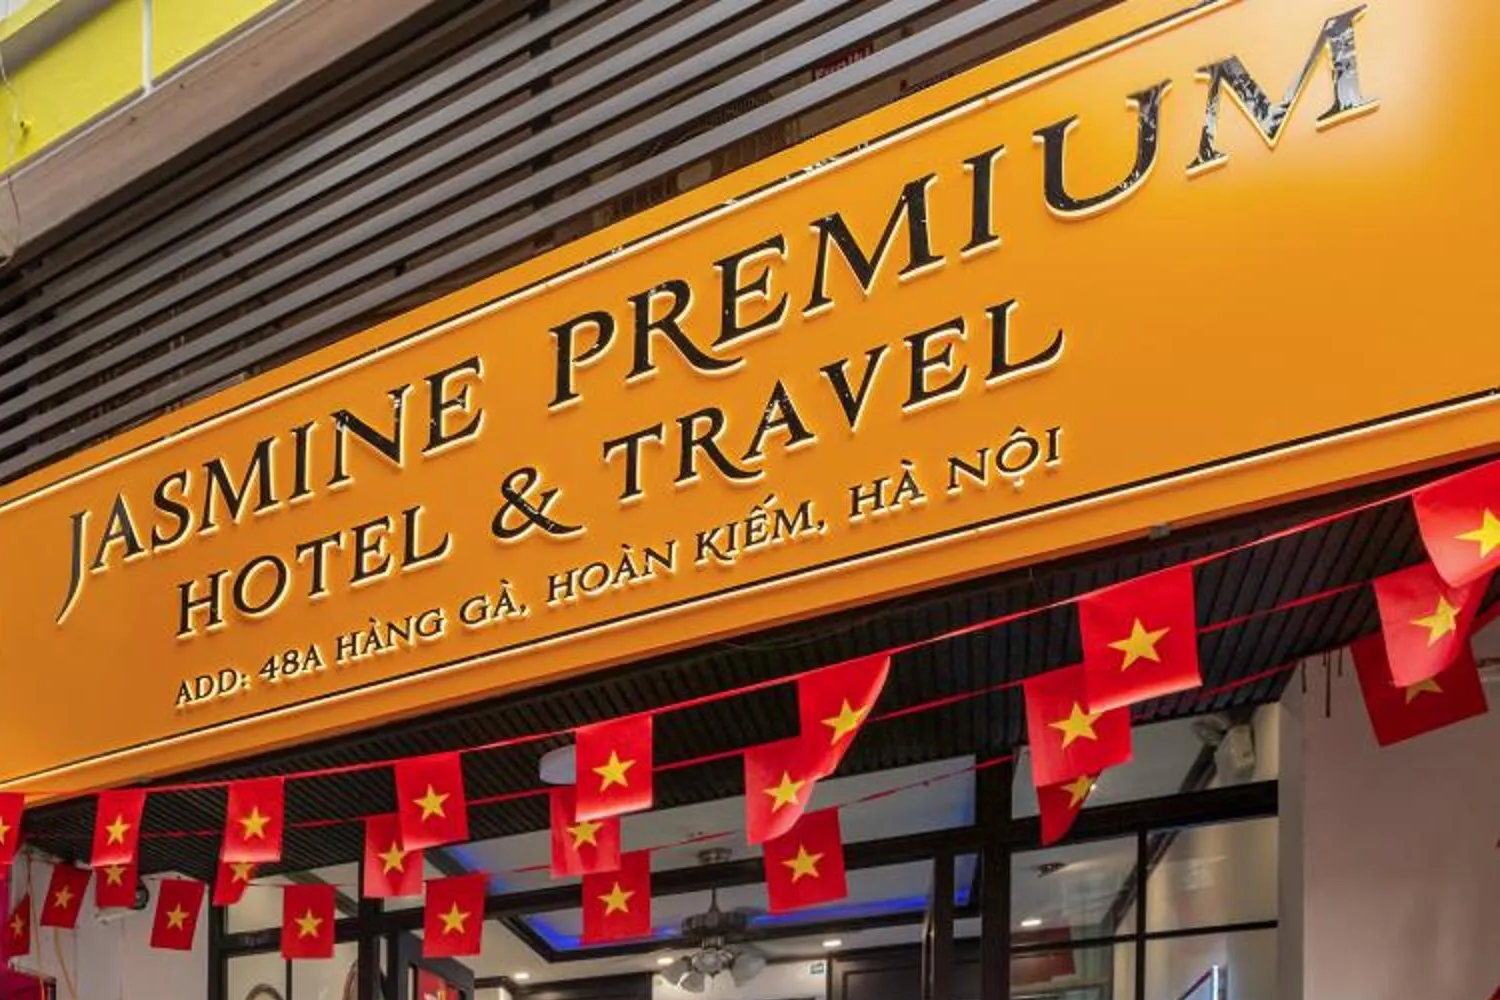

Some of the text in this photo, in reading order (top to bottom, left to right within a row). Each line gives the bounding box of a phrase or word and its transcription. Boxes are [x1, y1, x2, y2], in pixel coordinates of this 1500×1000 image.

[54, 3, 1382, 626] JASMINE PREMIUM
[175, 298, 1066, 642] HOTEL & TRAVEL
[175, 425, 1065, 708] ADD: 48A HÀNG GÀ, HOÀN KIẾM, HÀ NỘI
